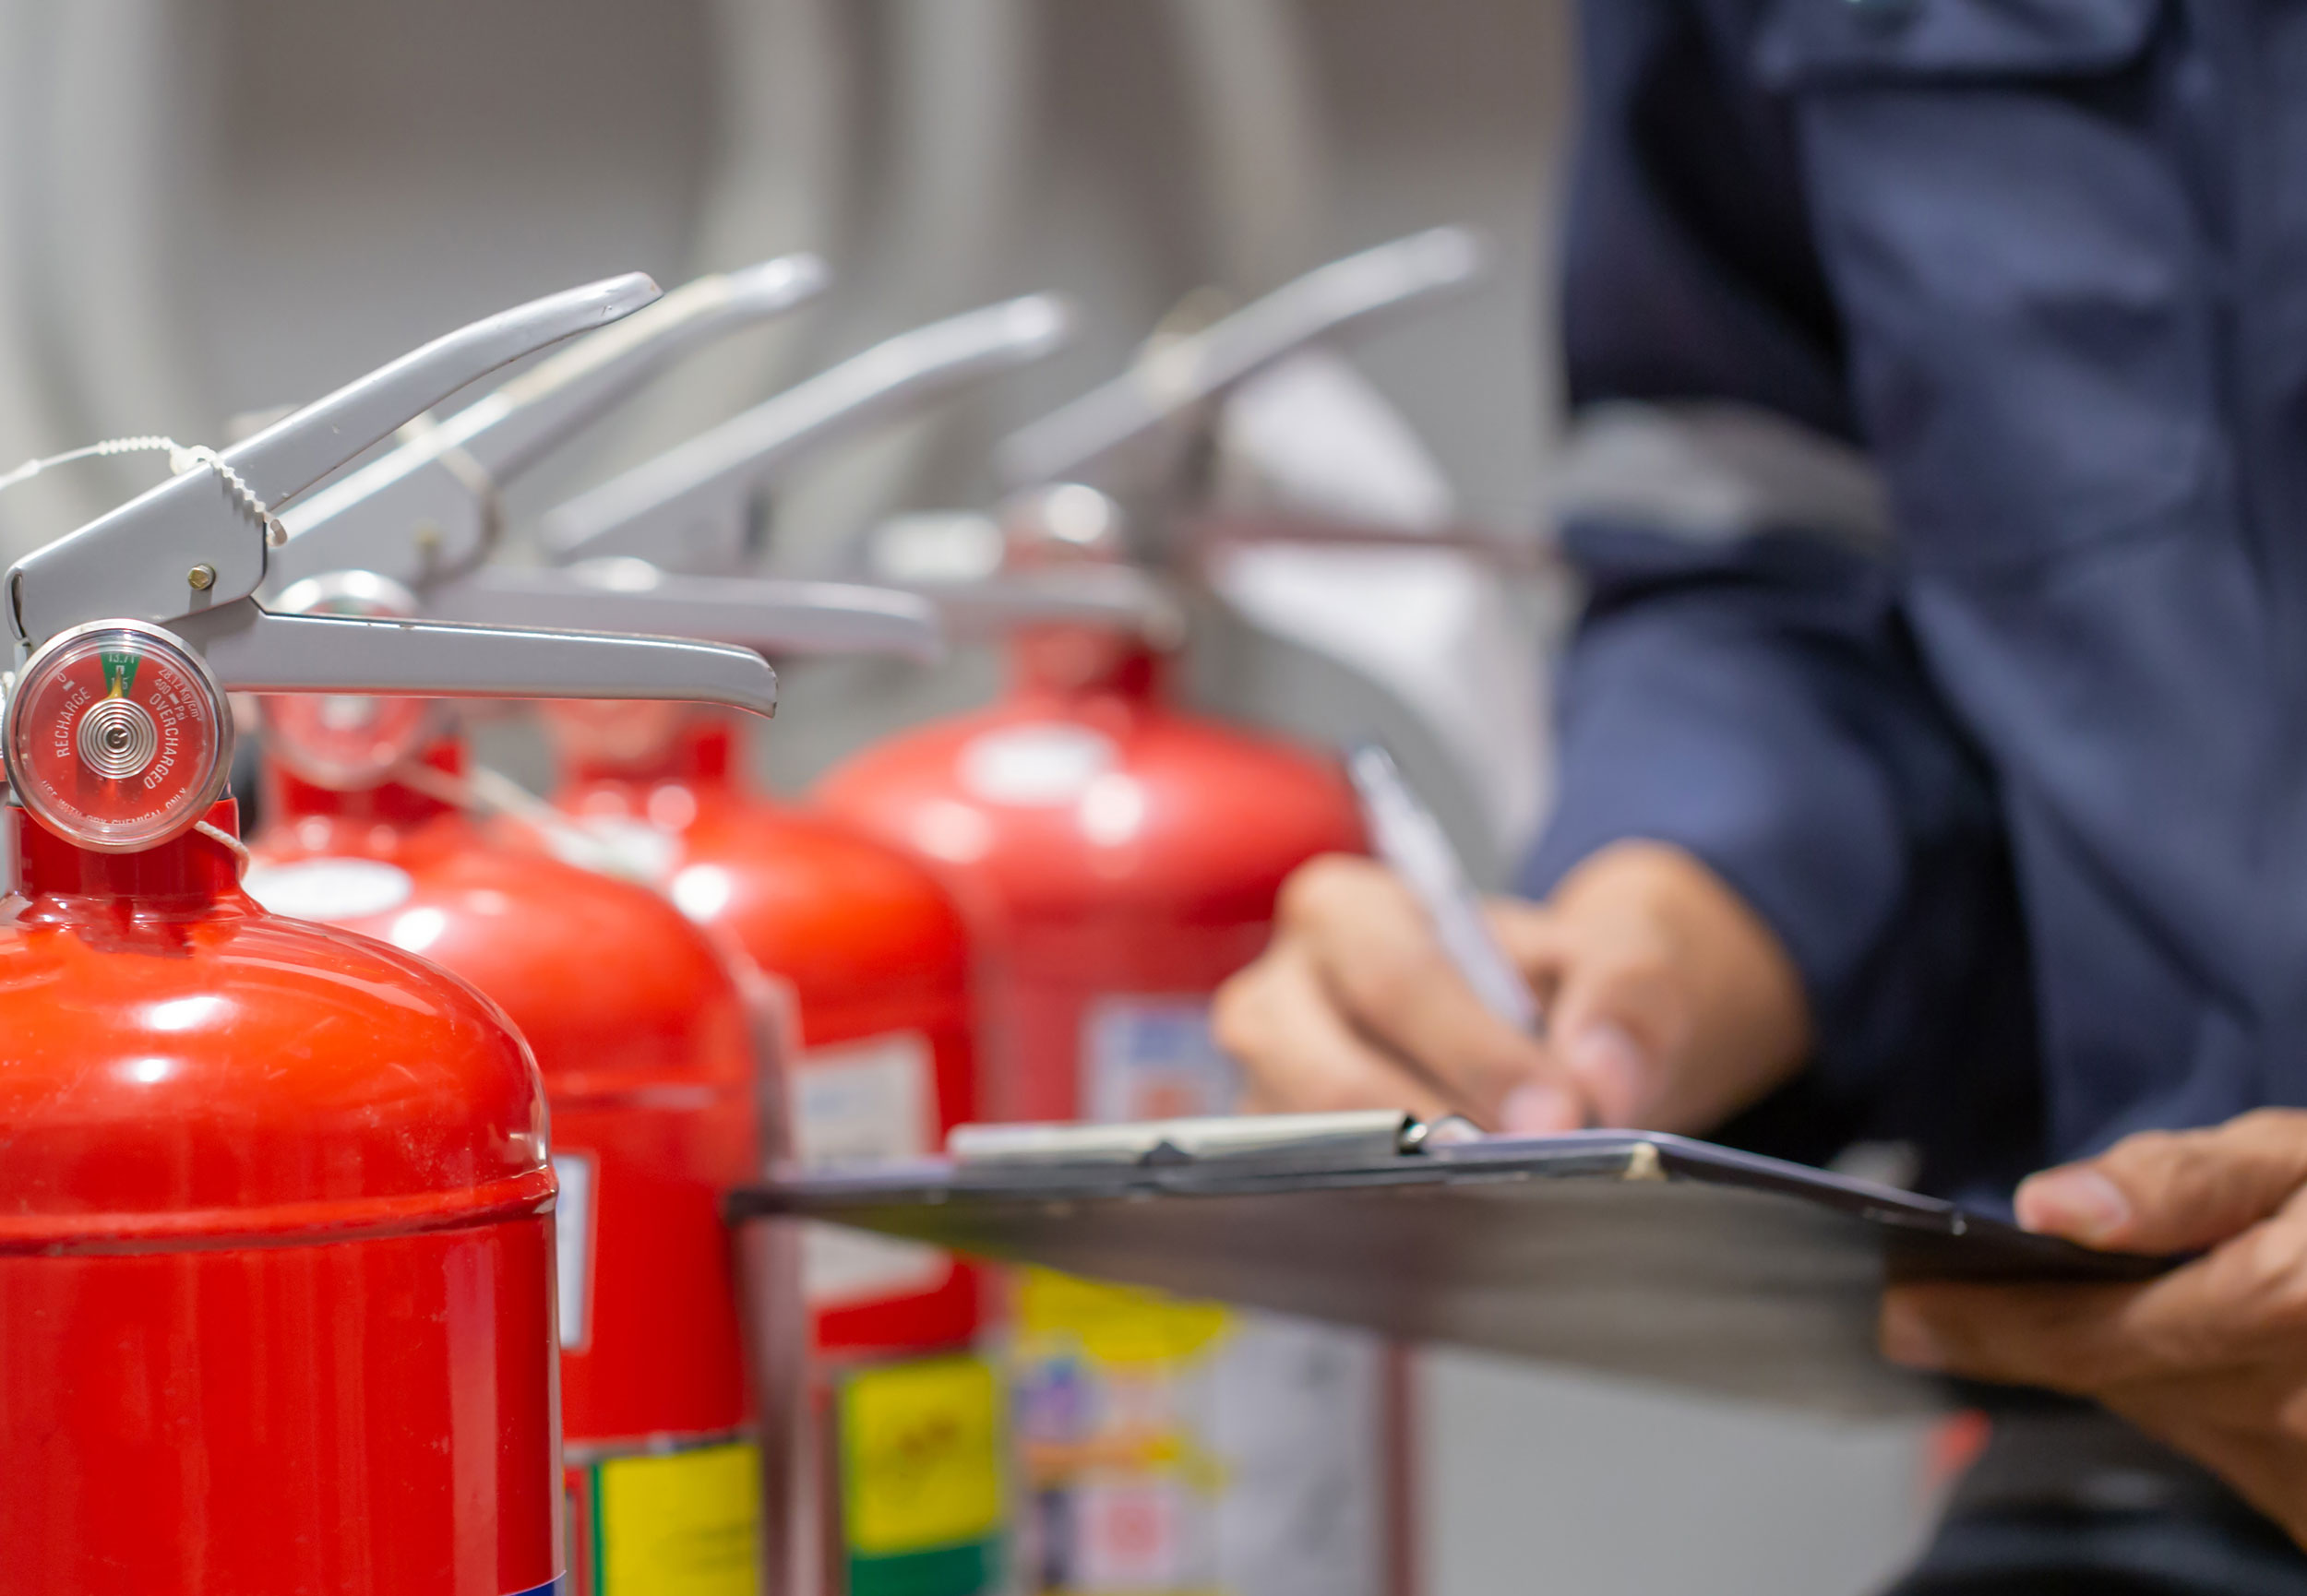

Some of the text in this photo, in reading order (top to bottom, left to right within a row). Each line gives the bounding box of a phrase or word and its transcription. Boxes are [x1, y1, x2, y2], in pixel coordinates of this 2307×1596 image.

[111, 676, 131, 690] 15
[154, 678, 172, 695] 400
[54, 686, 91, 757] RECHARGE
[143, 693, 179, 790] OVERCHARGED
